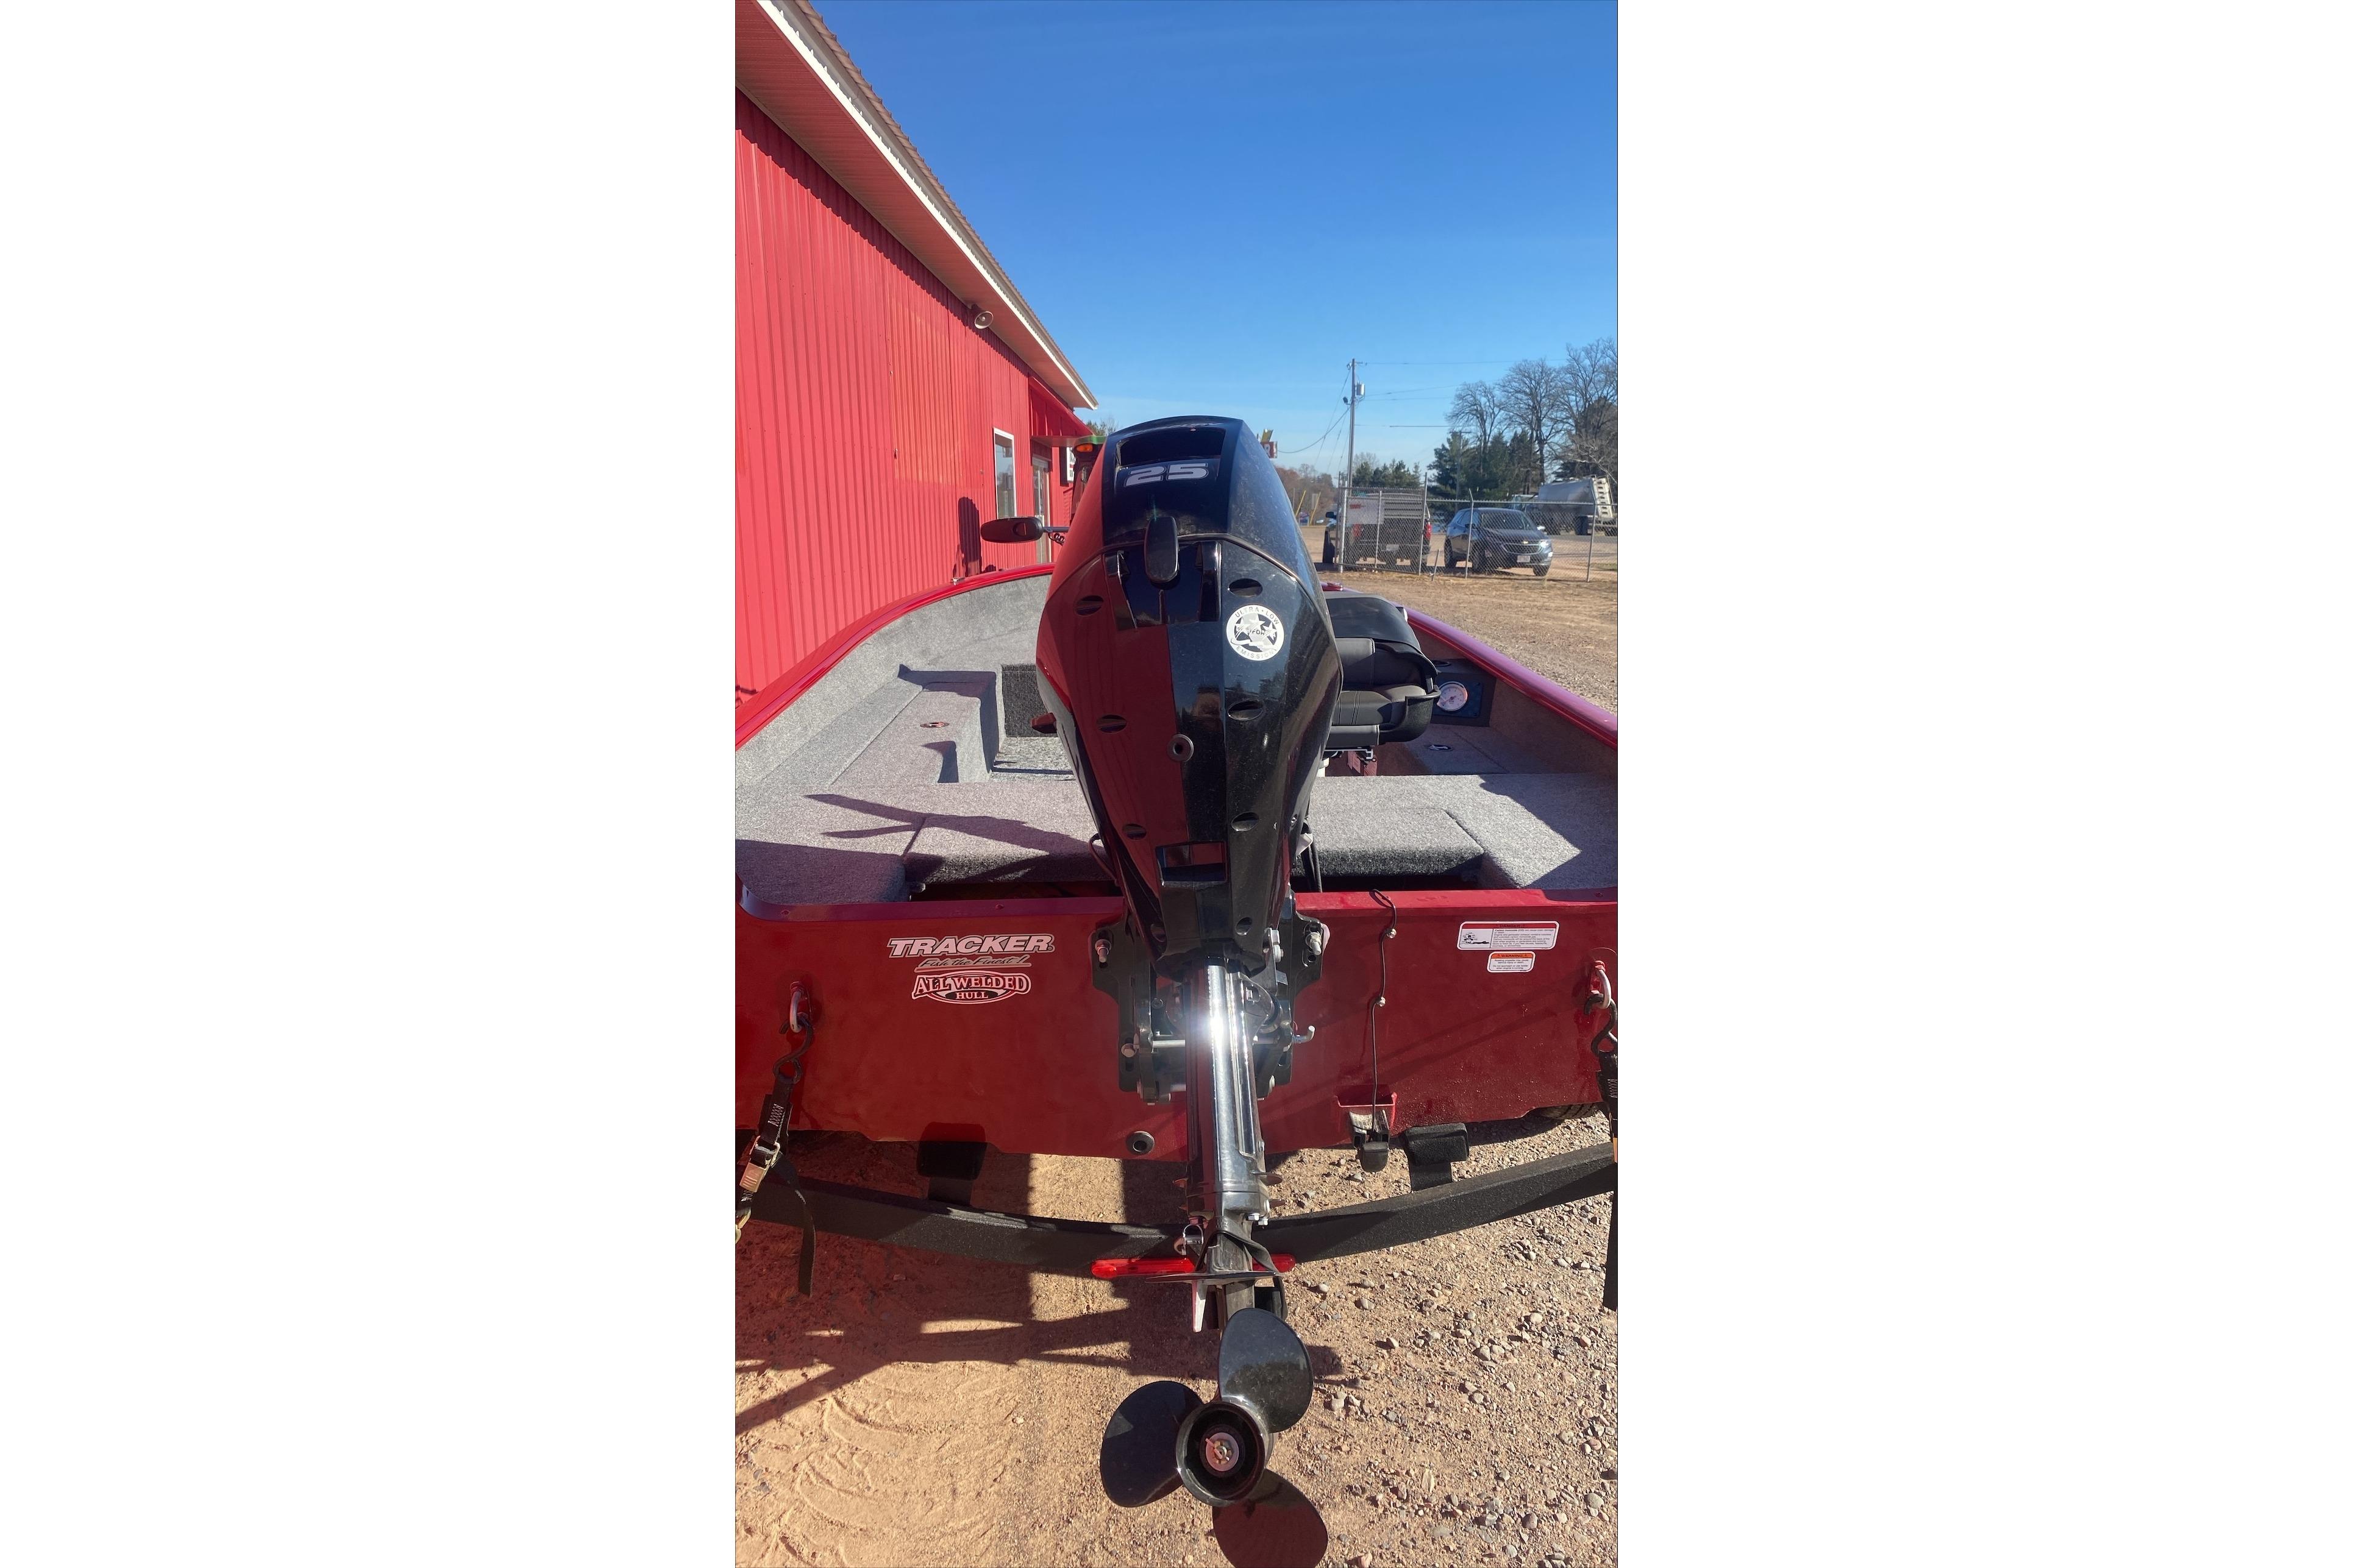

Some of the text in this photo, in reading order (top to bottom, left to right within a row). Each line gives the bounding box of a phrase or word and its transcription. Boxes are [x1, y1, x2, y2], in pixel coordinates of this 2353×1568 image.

[1124, 463, 1209, 488] 25
[1265, 610, 1280, 625] LOW
[889, 935, 1053, 956] TRACKER
[915, 976, 1028, 995] ALL WELDED
[955, 992, 989, 1000] HULL
